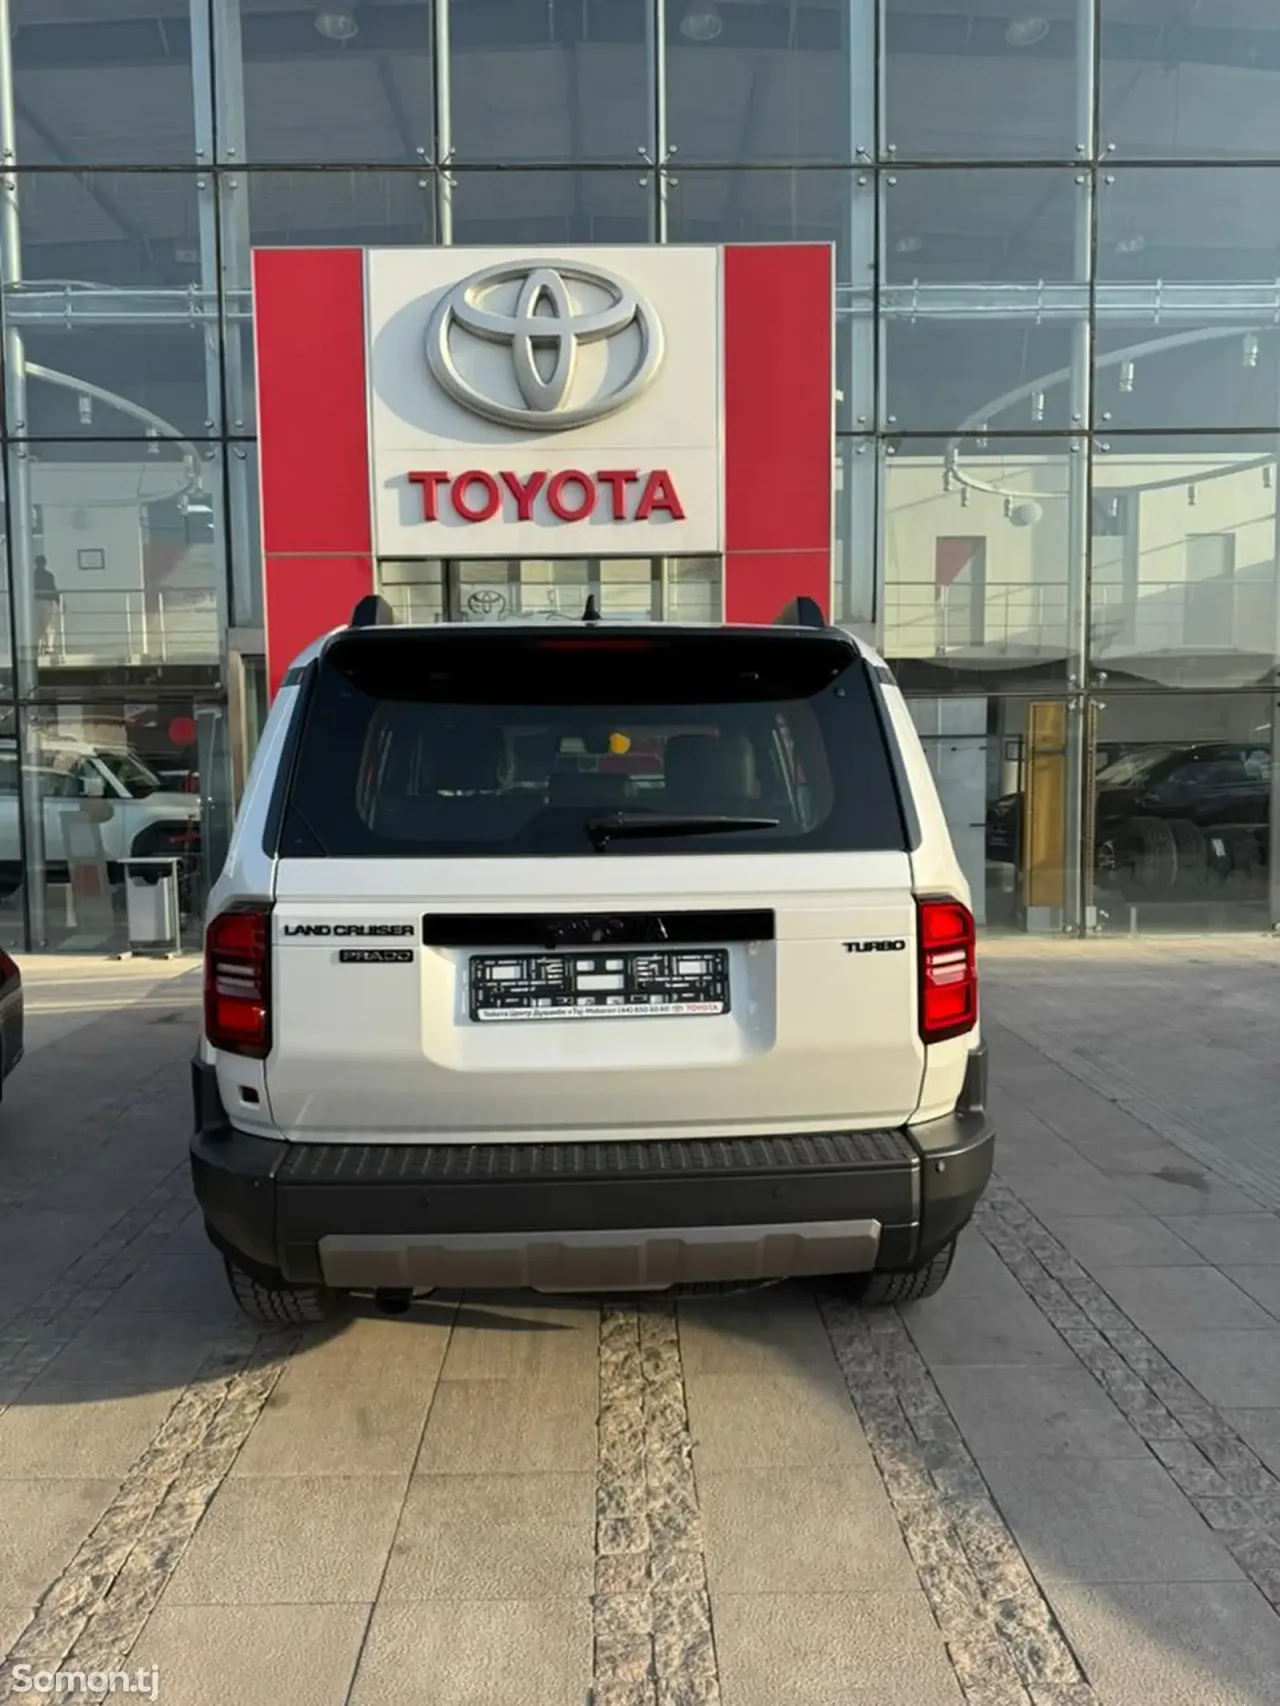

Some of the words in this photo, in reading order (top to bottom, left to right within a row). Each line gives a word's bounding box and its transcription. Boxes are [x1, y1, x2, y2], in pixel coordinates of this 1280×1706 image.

[408, 469, 686, 523] TOYOTA
[284, 924, 331, 936] LAND
[333, 924, 415, 936] CRUISER
[842, 939, 906, 953] TURBO
[342, 951, 411, 961] PRADO
[686, 1004, 719, 1012] TOYOTA
